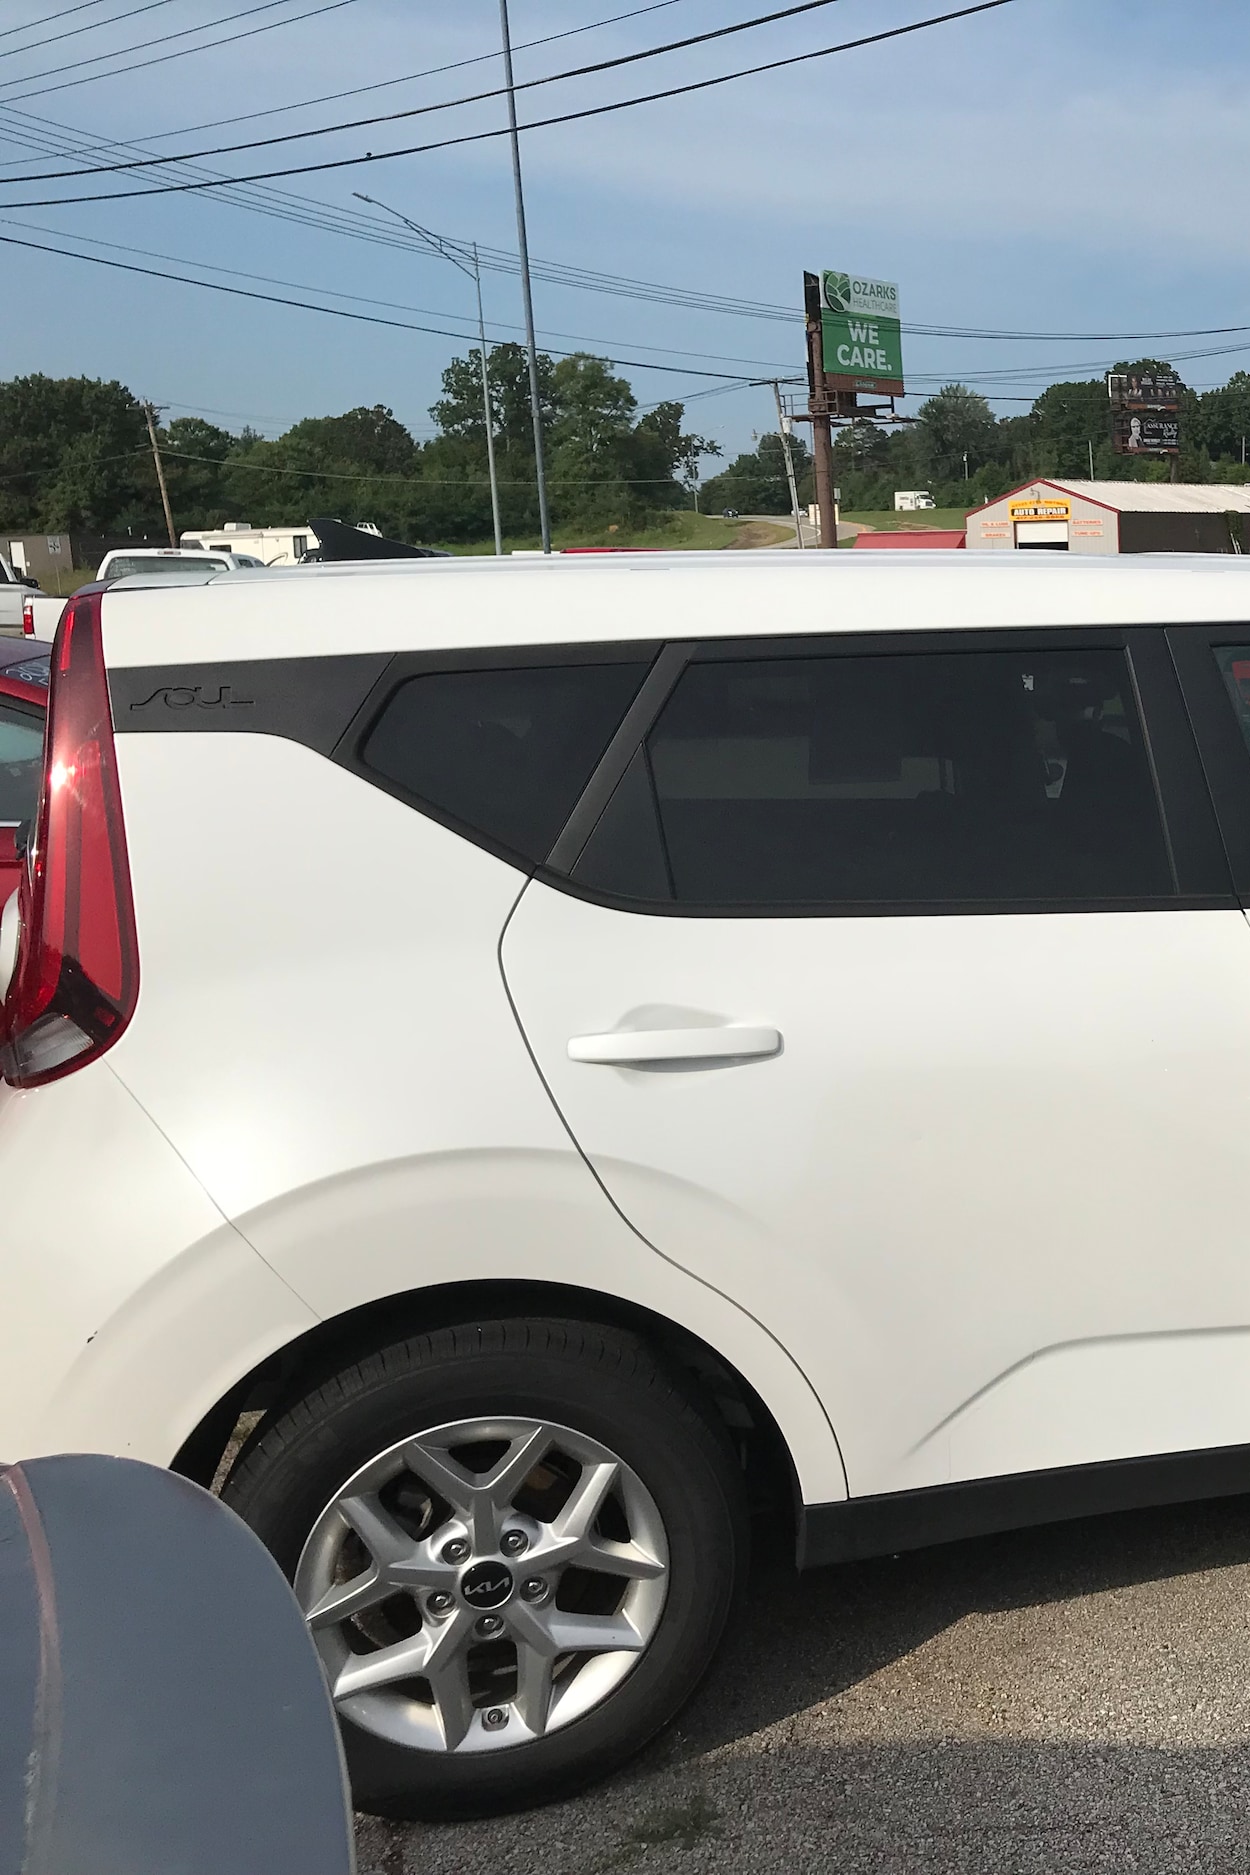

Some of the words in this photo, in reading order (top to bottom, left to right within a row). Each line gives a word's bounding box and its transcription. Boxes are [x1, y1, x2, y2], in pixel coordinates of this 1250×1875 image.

[852, 281, 896, 300] OZARKS
[852, 299, 897, 313] HEALTHCARE
[848, 320, 879, 345] WE
[837, 344, 893, 371] CARE.
[1014, 508, 1035, 516] AUTO
[1037, 507, 1067, 515] REPAIR
[130, 687, 255, 710] SOUL
